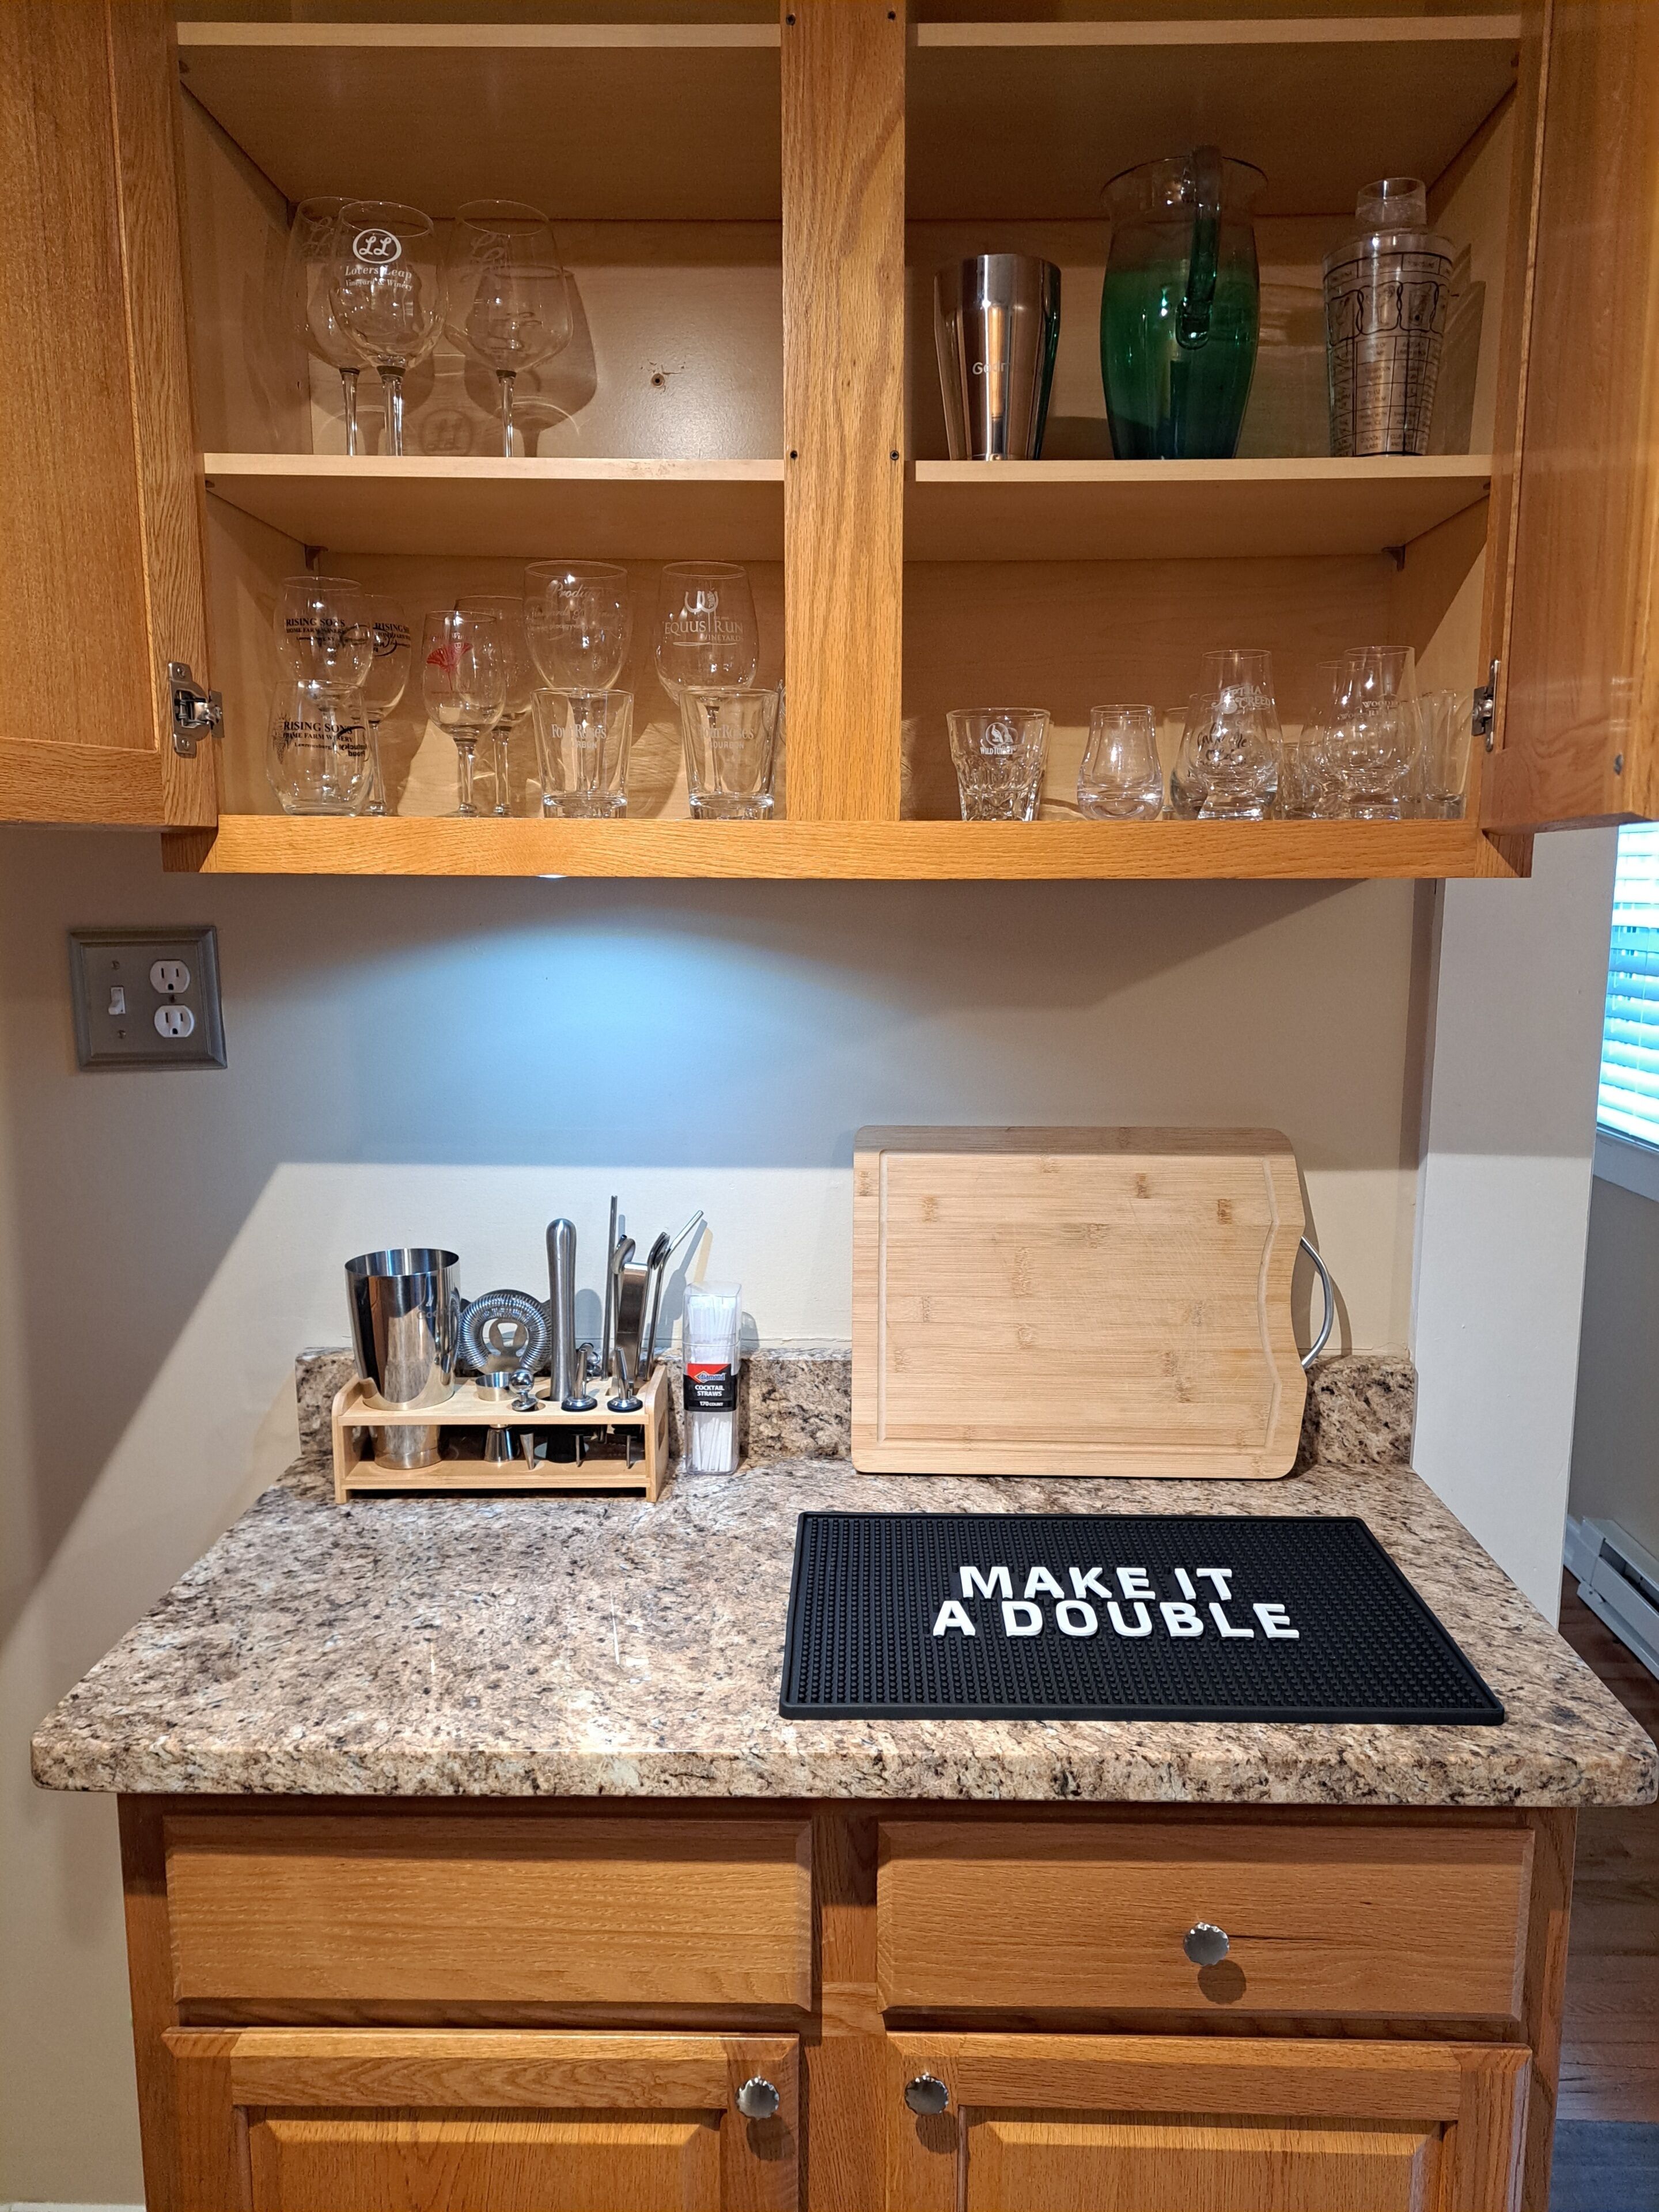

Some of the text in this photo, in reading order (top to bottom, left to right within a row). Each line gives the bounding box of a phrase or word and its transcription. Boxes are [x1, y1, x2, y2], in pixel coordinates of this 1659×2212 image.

[345, 266, 412, 282] Lovers Leap
[346, 279, 374, 287] Vineyard
[387, 279, 412, 291] Winery
[286, 618, 345, 627] RISING SOS
[665, 620, 743, 636] EQUUS RUN
[283, 721, 353, 734] RISING SONS
[980, 747, 994, 755] WILD
[959, 1566, 1233, 1600] MAKE IT
[933, 1600, 1300, 1639] A DOUBLE
